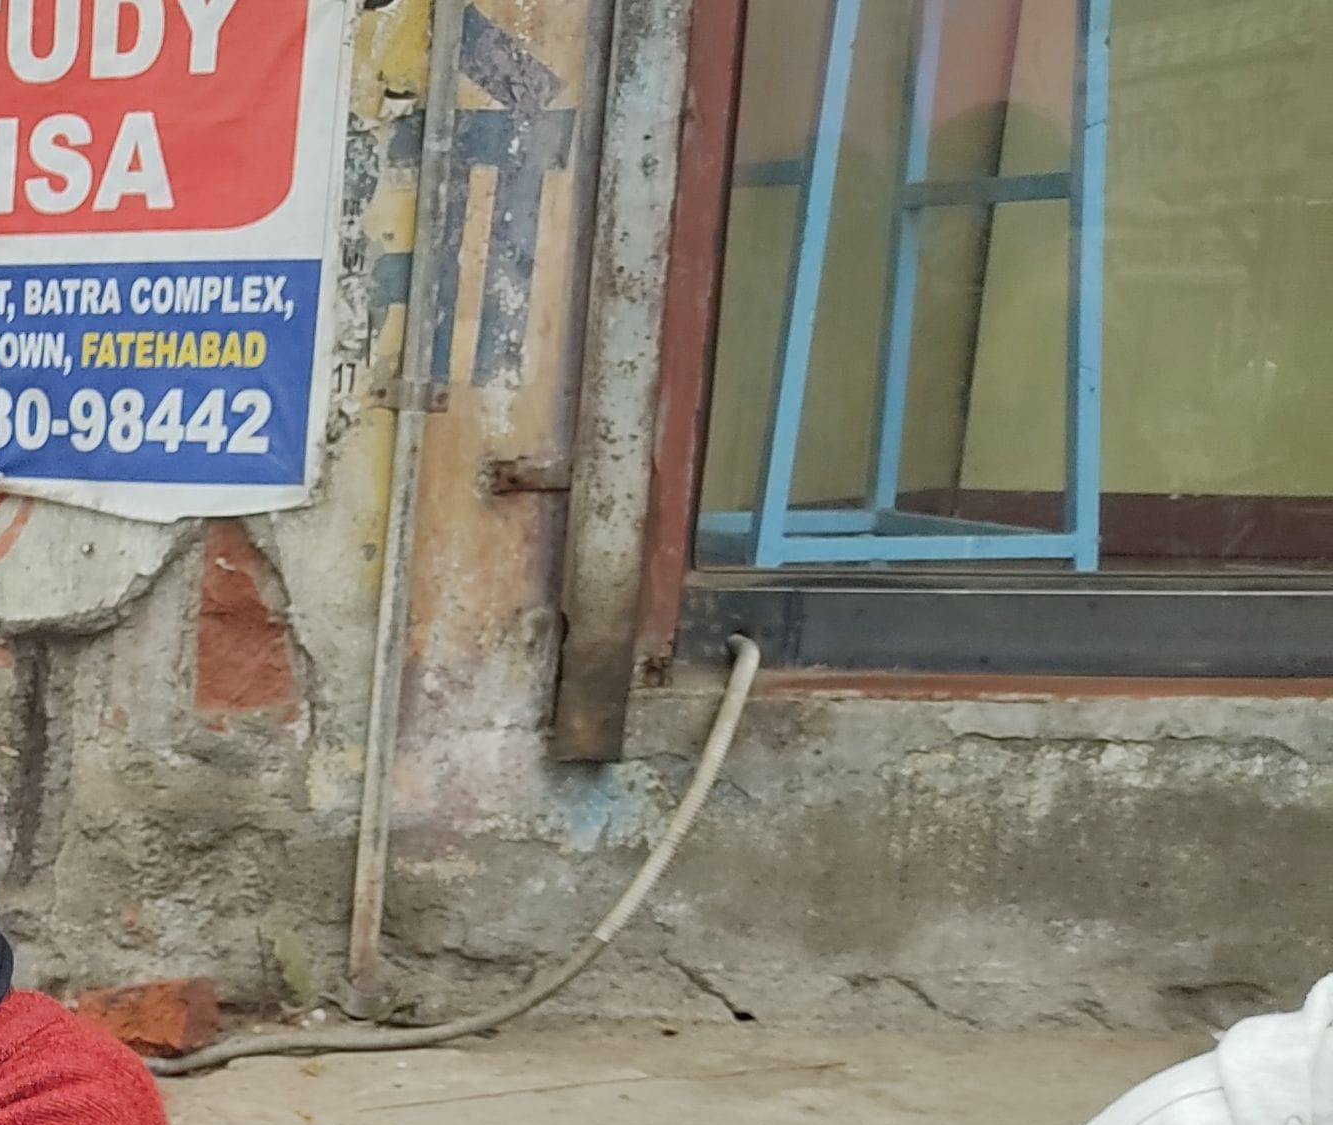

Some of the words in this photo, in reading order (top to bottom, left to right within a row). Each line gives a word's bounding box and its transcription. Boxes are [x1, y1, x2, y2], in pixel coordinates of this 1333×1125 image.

[23, 277, 122, 316] BATRA
[130, 274, 294, 320] COMPLEX,
[81, 330, 267, 369] FATEHABAD
